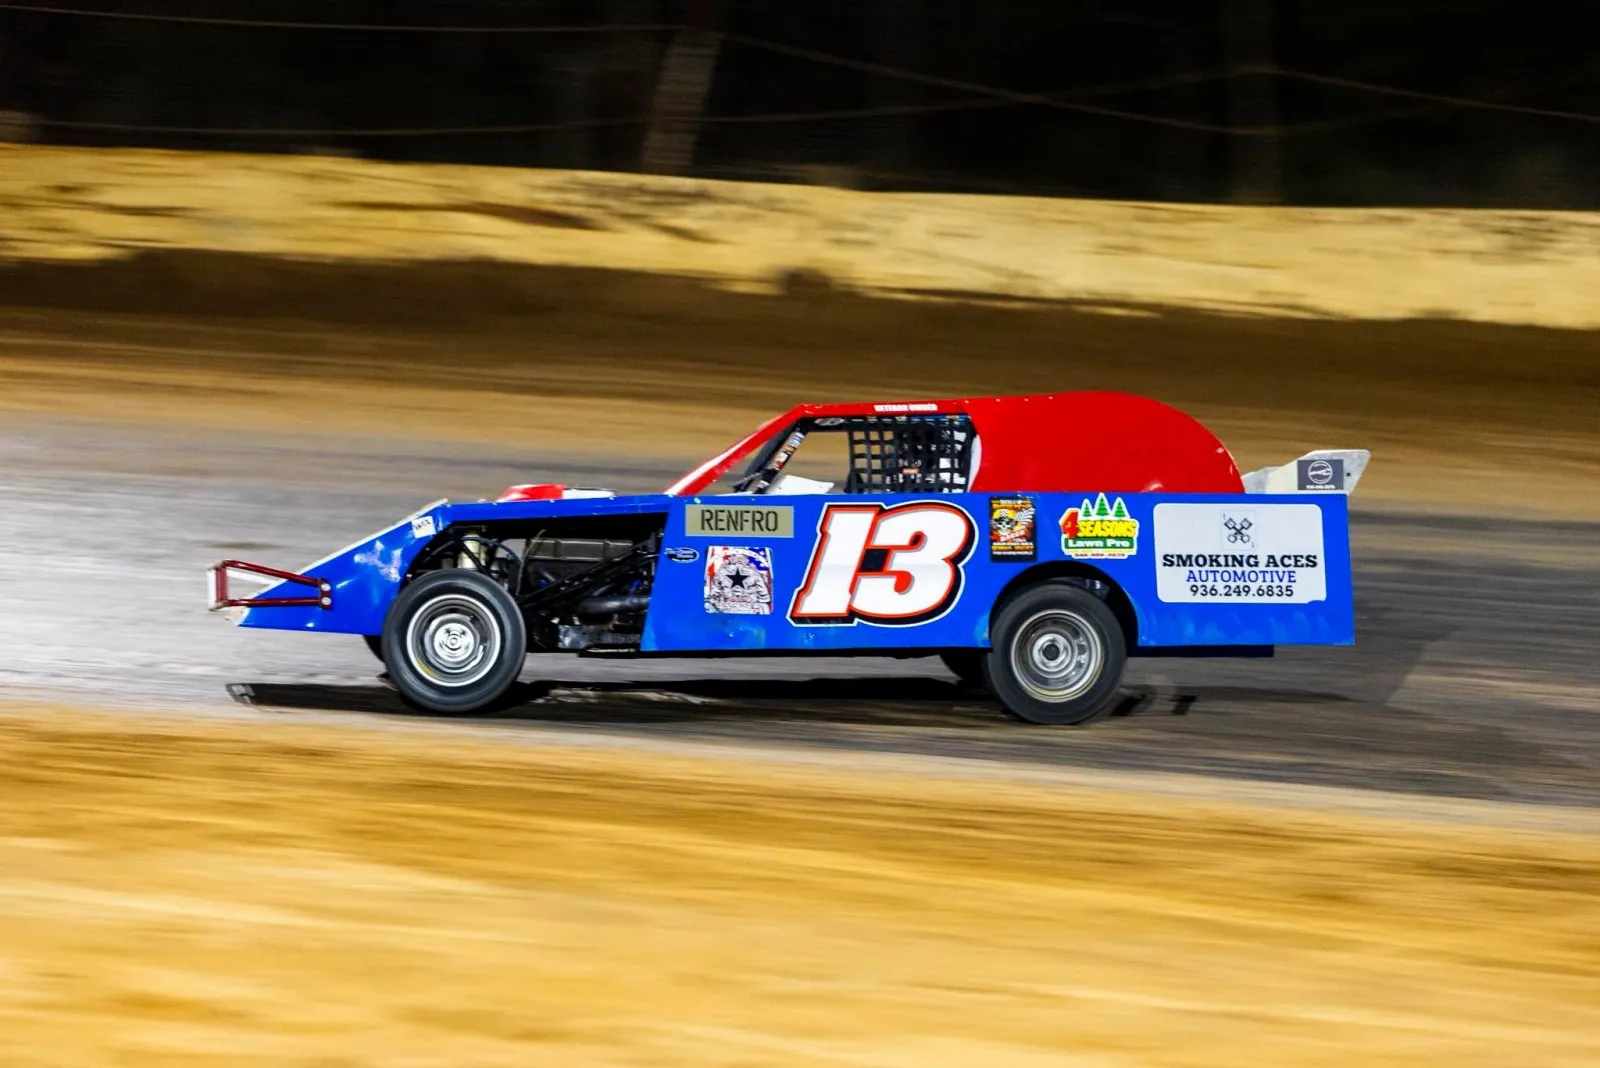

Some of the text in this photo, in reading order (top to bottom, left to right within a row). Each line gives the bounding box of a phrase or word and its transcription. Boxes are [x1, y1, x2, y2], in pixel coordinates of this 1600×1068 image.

[700, 509, 779, 532] RENFRO
[1061, 509, 1137, 540] 4 SEASONS
[1067, 539, 1131, 548] Lawn Pro
[787, 502, 976, 627] 13
[1162, 554, 1318, 568] SMOKING ACES
[1186, 570, 1297, 583] AUTOMOTIVE
[1189, 585, 1294, 597] 936.249.6835
